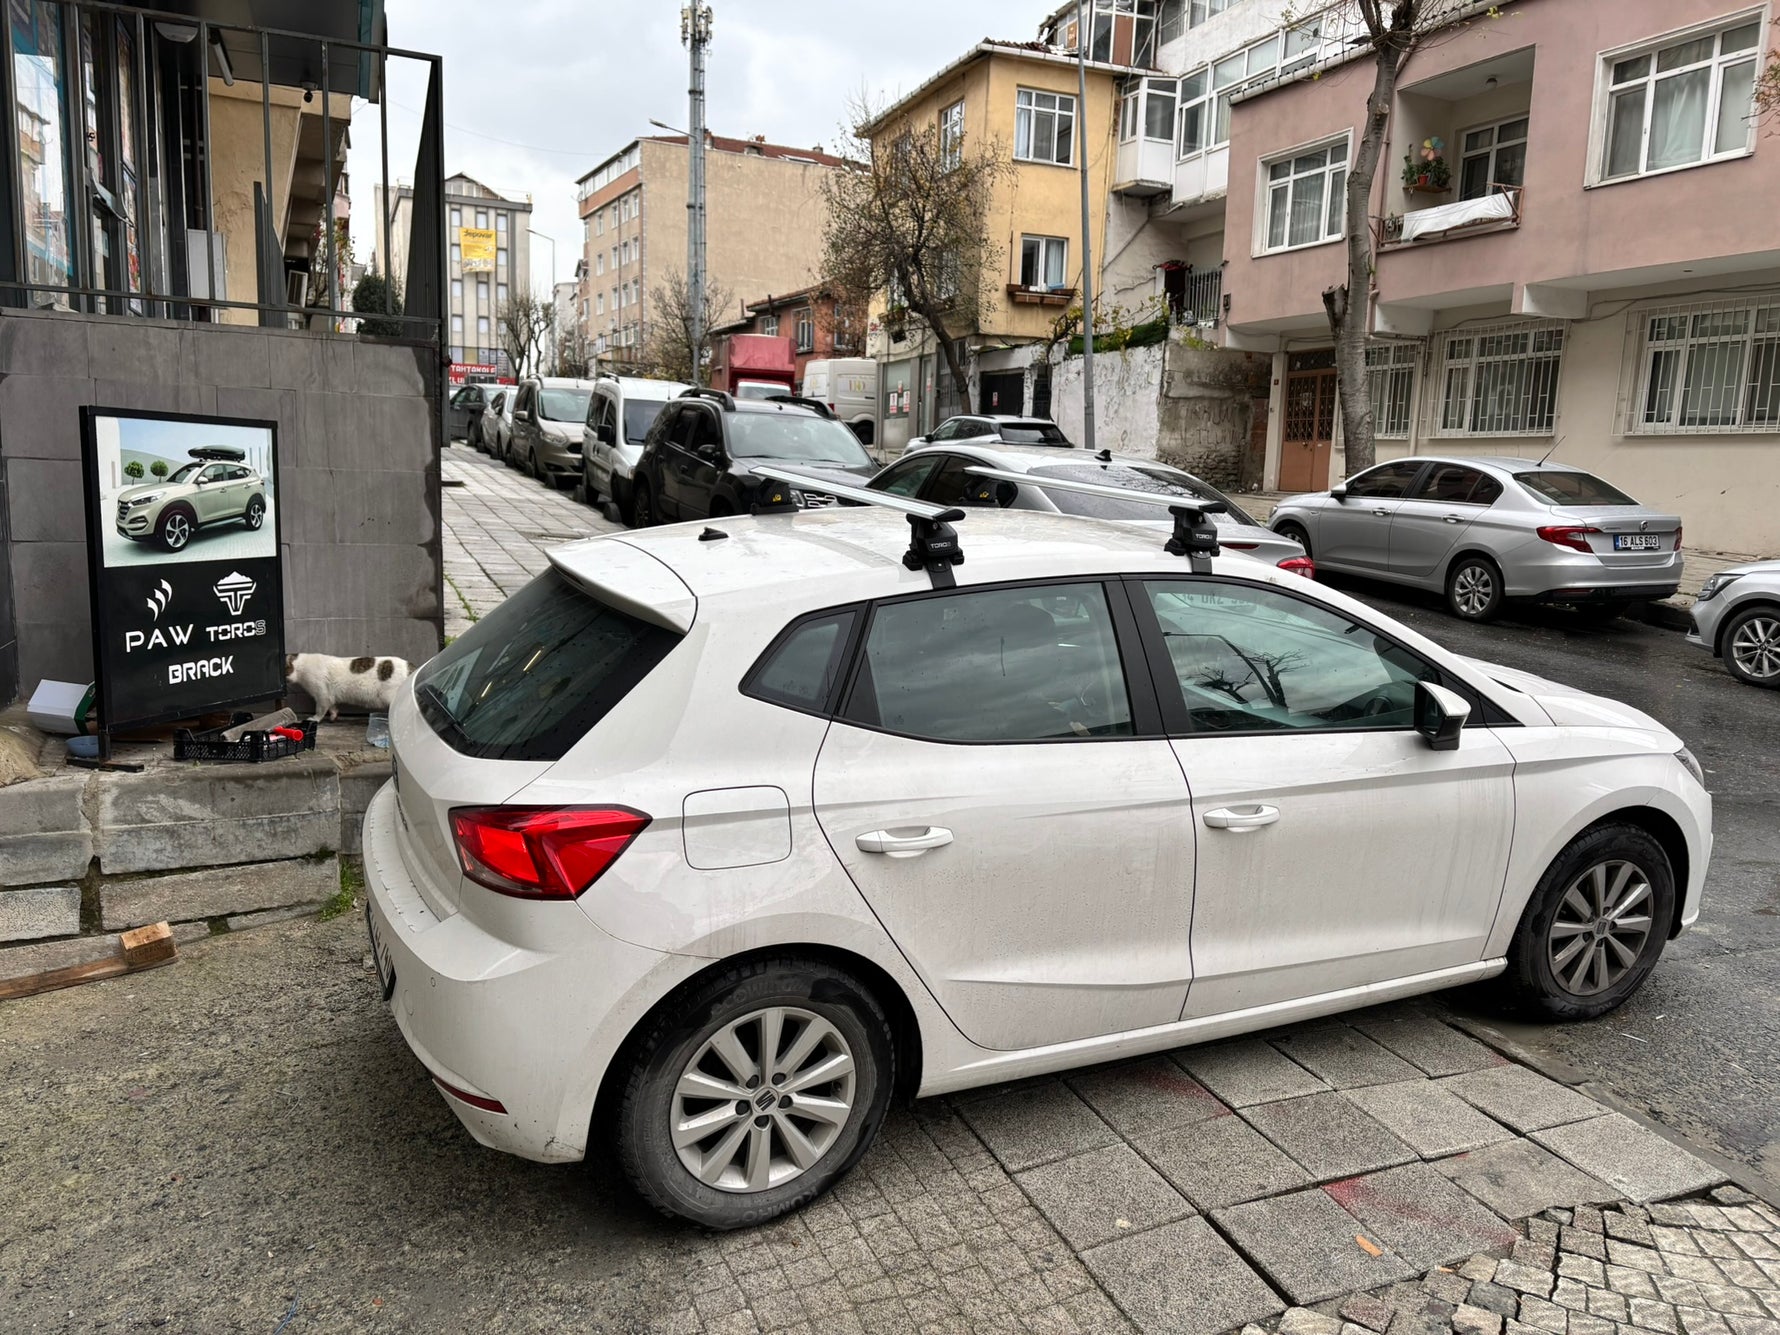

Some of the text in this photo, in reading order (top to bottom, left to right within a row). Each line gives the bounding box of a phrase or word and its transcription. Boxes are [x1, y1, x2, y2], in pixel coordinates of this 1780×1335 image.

[1620, 536, 1628, 546] 16
[1630, 536, 1643, 546] ALS
[125, 624, 194, 653] PAW
[205, 619, 266, 642] TOROS
[168, 655, 234, 685] BRACK
